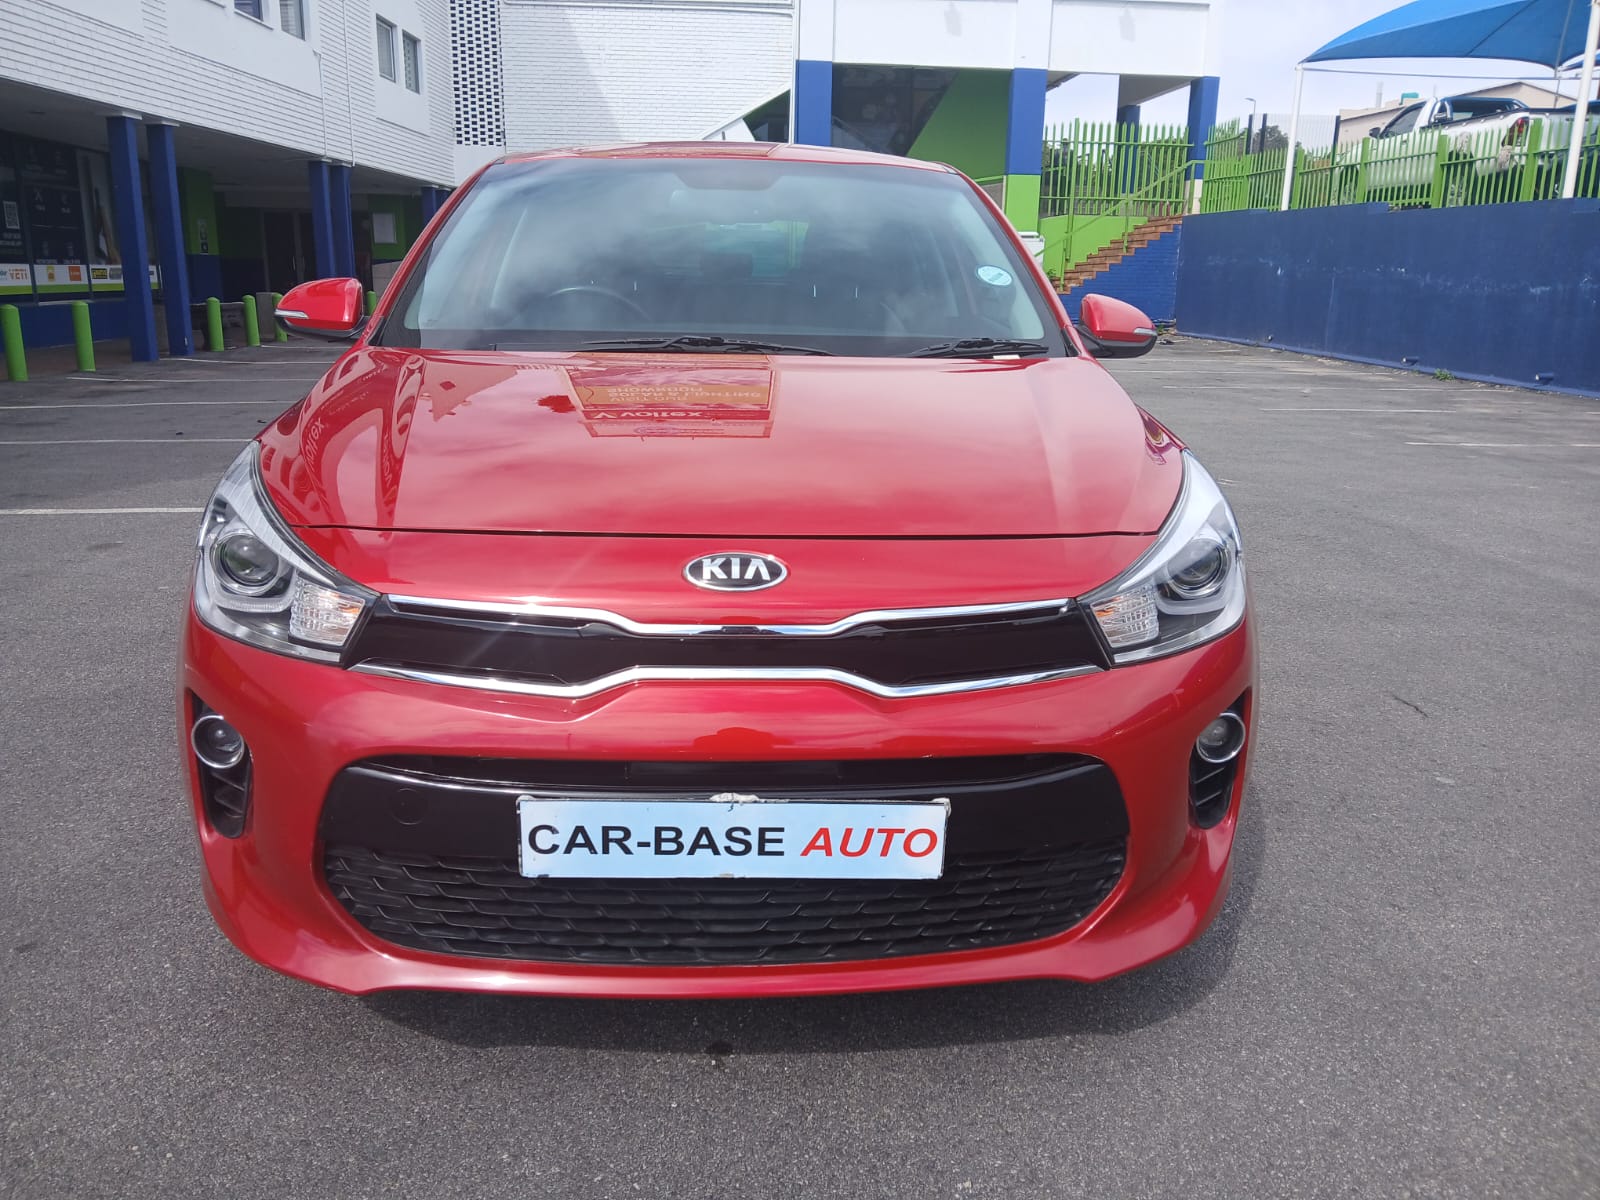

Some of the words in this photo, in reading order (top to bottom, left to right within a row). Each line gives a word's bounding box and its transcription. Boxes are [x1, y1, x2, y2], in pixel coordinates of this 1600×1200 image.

[702, 557, 771, 581] KIA
[528, 825, 785, 856] CAR-BASE
[800, 827, 938, 857] AUTO
